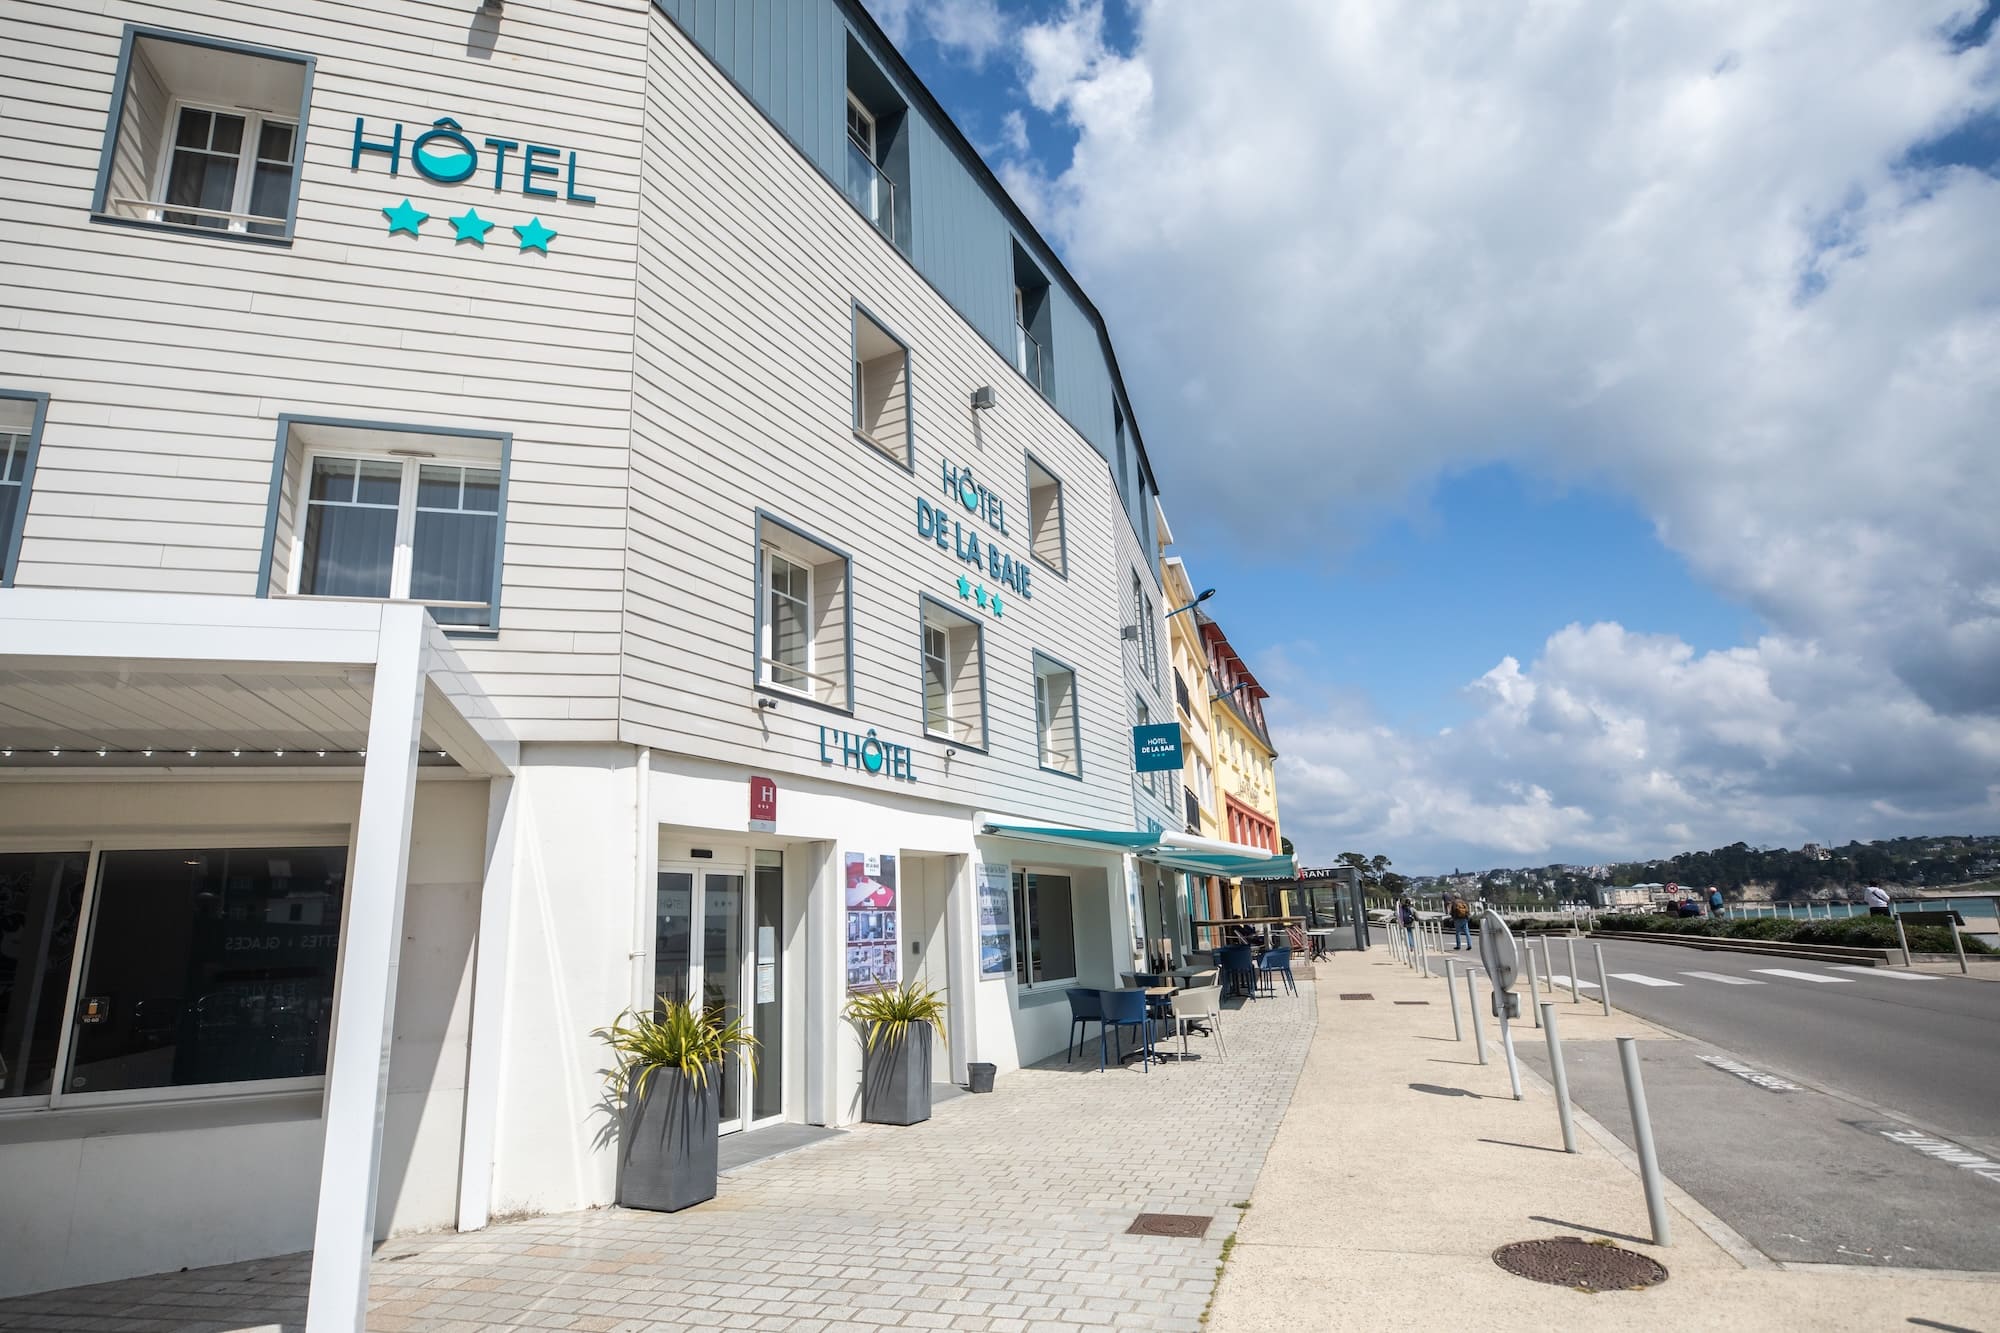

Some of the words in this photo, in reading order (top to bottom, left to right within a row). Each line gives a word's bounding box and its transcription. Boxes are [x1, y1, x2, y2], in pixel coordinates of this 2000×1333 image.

[351, 117, 597, 204] HÔTEL
[943, 459, 1009, 537] HÔTEL
[917, 496, 949, 550] DE
[956, 521, 984, 571] LA
[989, 543, 1032, 599] BAIE
[820, 725, 917, 781] L'HÔTEL
[1147, 737, 1168, 746] HÔTEL
[761, 785, 774, 803] H
